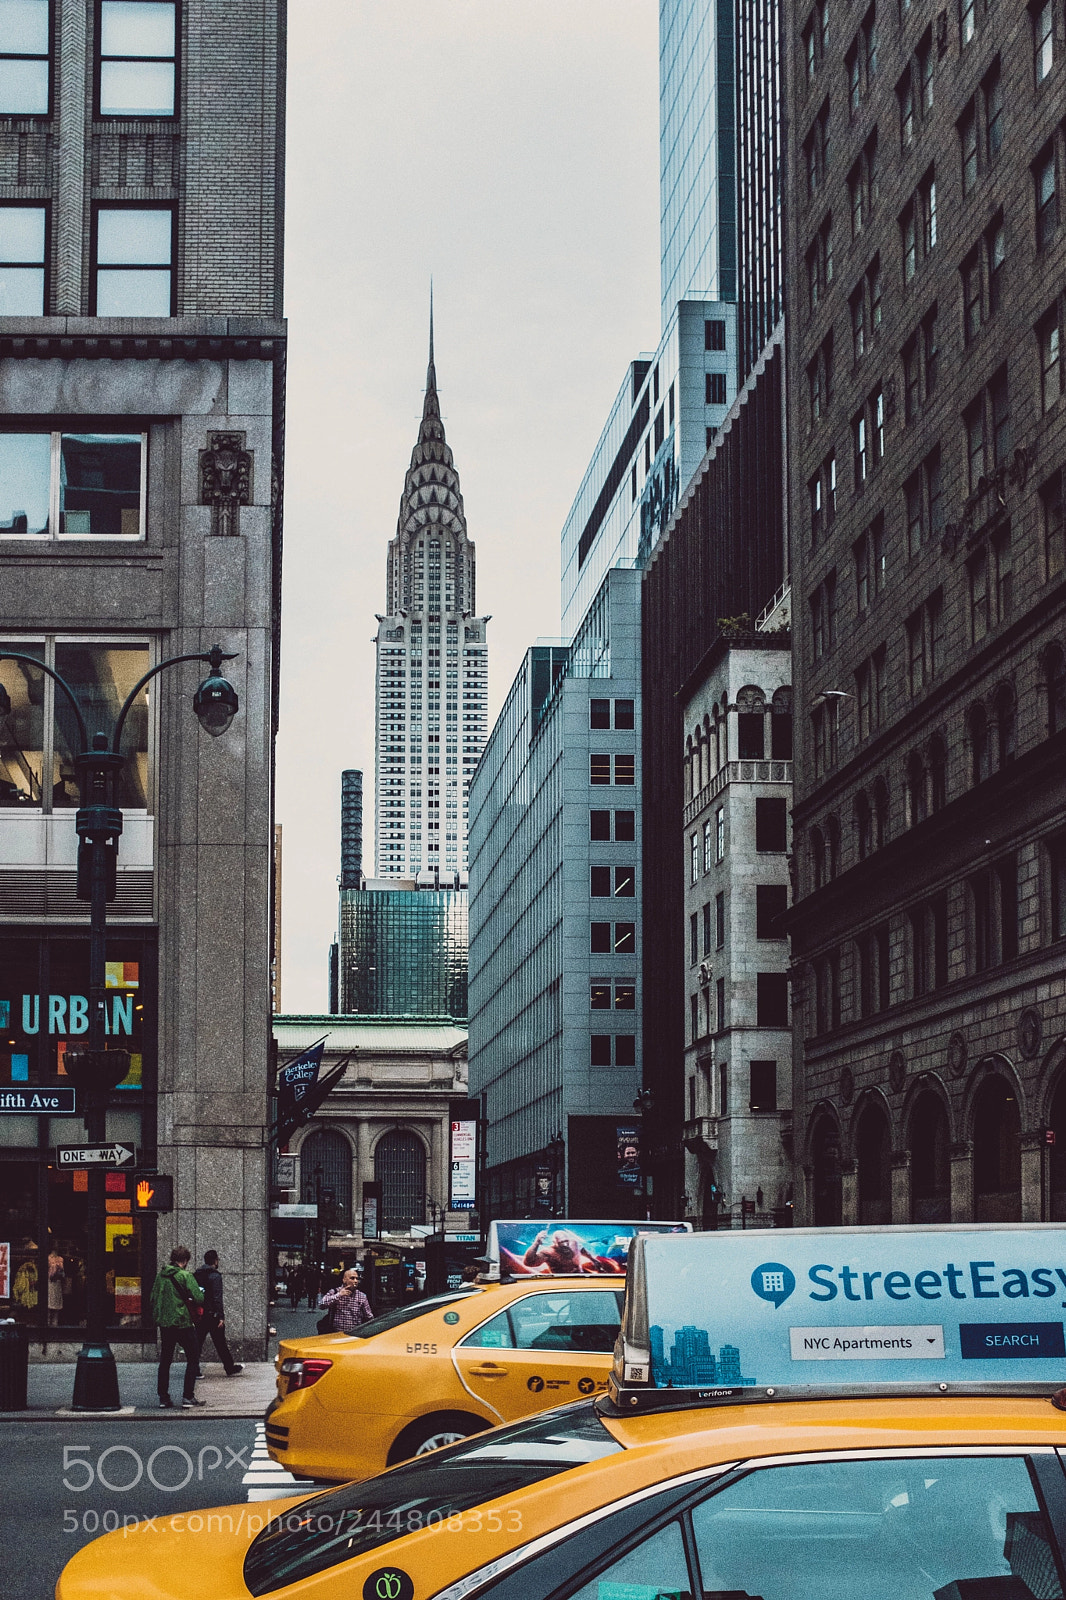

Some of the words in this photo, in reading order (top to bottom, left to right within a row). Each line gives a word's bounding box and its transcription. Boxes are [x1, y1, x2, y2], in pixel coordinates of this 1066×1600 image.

[0, 1093, 26, 1108] ifth
[30, 1093, 59, 1108] Ave
[454, 1123, 459, 1131] 3
[63, 1151, 86, 1162] ONE
[99, 1149, 123, 1161] WAY
[453, 1162, 458, 1170] 6
[804, 1336, 830, 1350] NYC
[833, 1336, 912, 1352] Apartments
[985, 1334, 1039, 1346] SEARCH
[698, 1389, 733, 1398] Verifone
